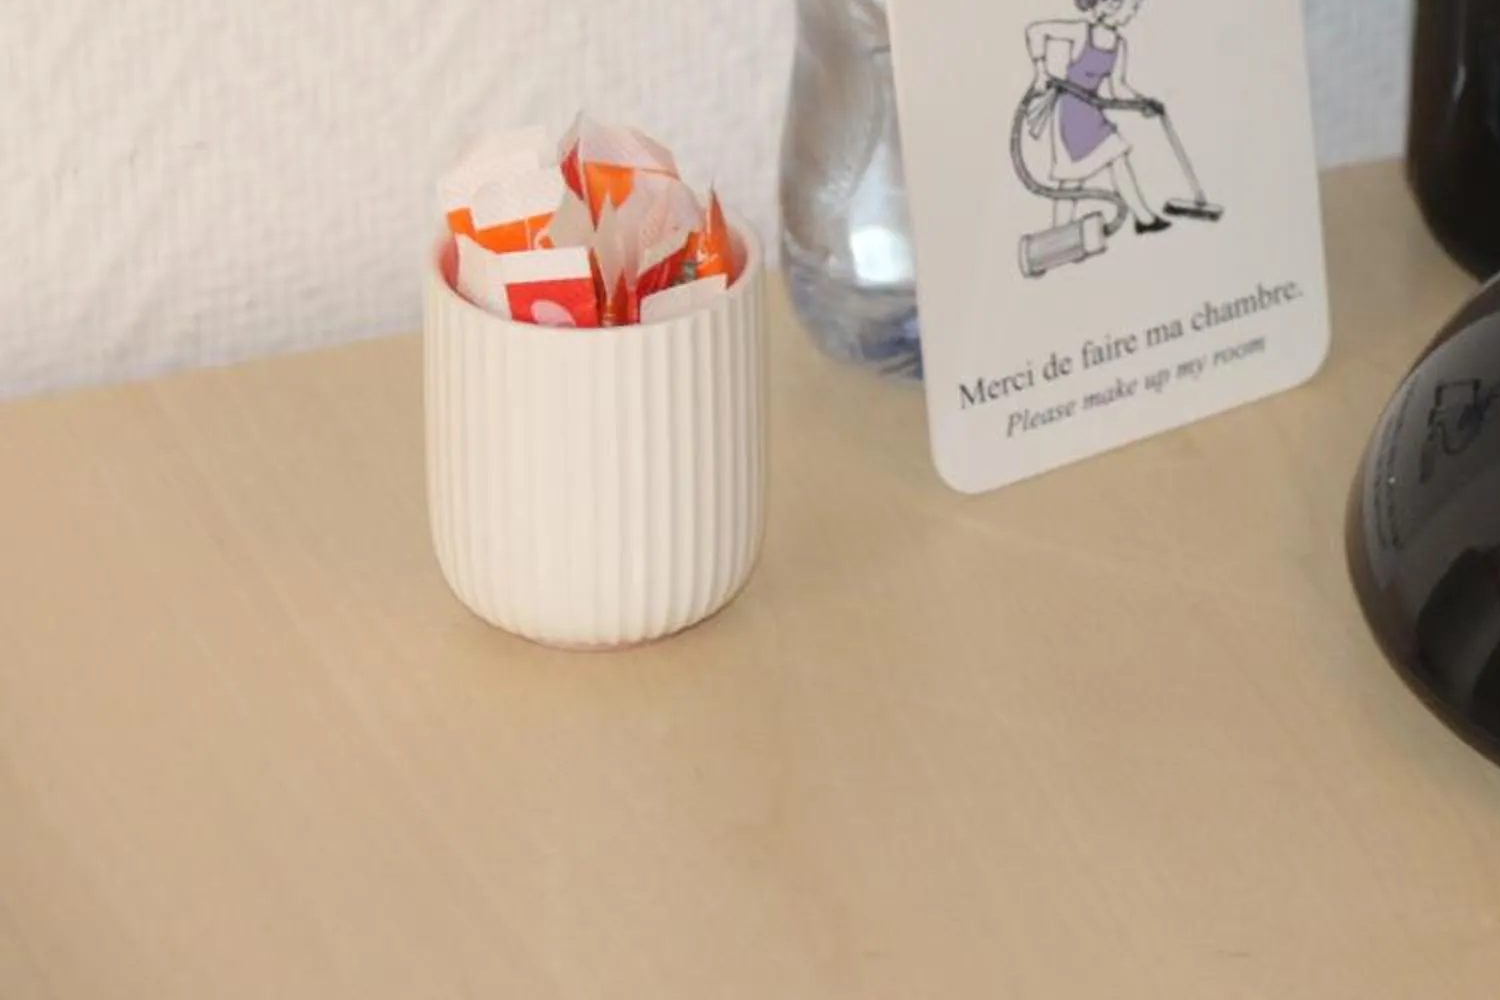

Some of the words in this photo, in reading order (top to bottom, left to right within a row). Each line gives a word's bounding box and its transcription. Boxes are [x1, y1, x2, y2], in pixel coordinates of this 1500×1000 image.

[959, 360, 1035, 409] Merci
[1042, 352, 1073, 382] de
[1081, 334, 1138, 370] faire
[1146, 318, 1185, 347] ma
[1190, 279, 1304, 332] chambre.
[1006, 400, 1077, 438] Please
[1083, 377, 1138, 410] make
[1144, 368, 1172, 393] up
[1176, 354, 1207, 379] my
[1213, 335, 1266, 367] room
